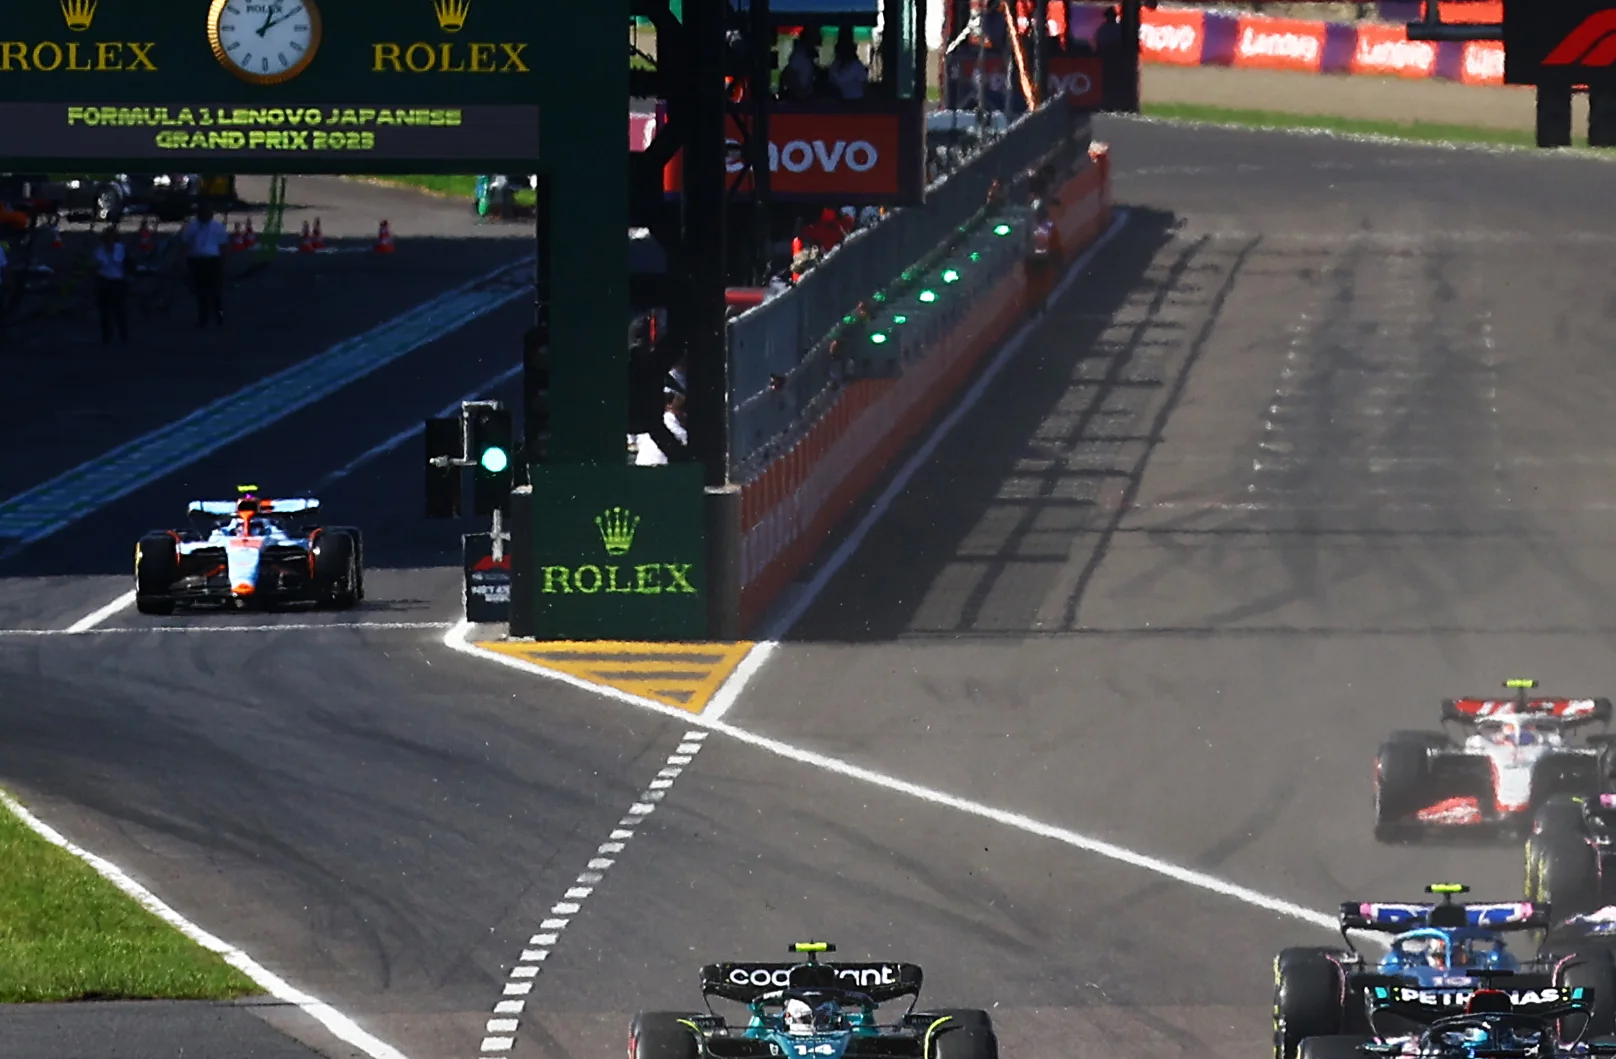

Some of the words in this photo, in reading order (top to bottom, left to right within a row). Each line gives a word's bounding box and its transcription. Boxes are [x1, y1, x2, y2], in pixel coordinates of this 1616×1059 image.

[0, 42, 157, 72] ROLEX
[372, 43, 530, 73] ROLEX
[67, 107, 195, 126] FORMULA
[200, 107, 214, 126] 1
[217, 108, 322, 126] LENOVO
[326, 108, 462, 126] JAPANESE
[156, 131, 245, 149] GRAND
[249, 131, 308, 149] PRIX
[541, 563, 697, 594] ROLEX
[794, 1044, 835, 1056] 14
